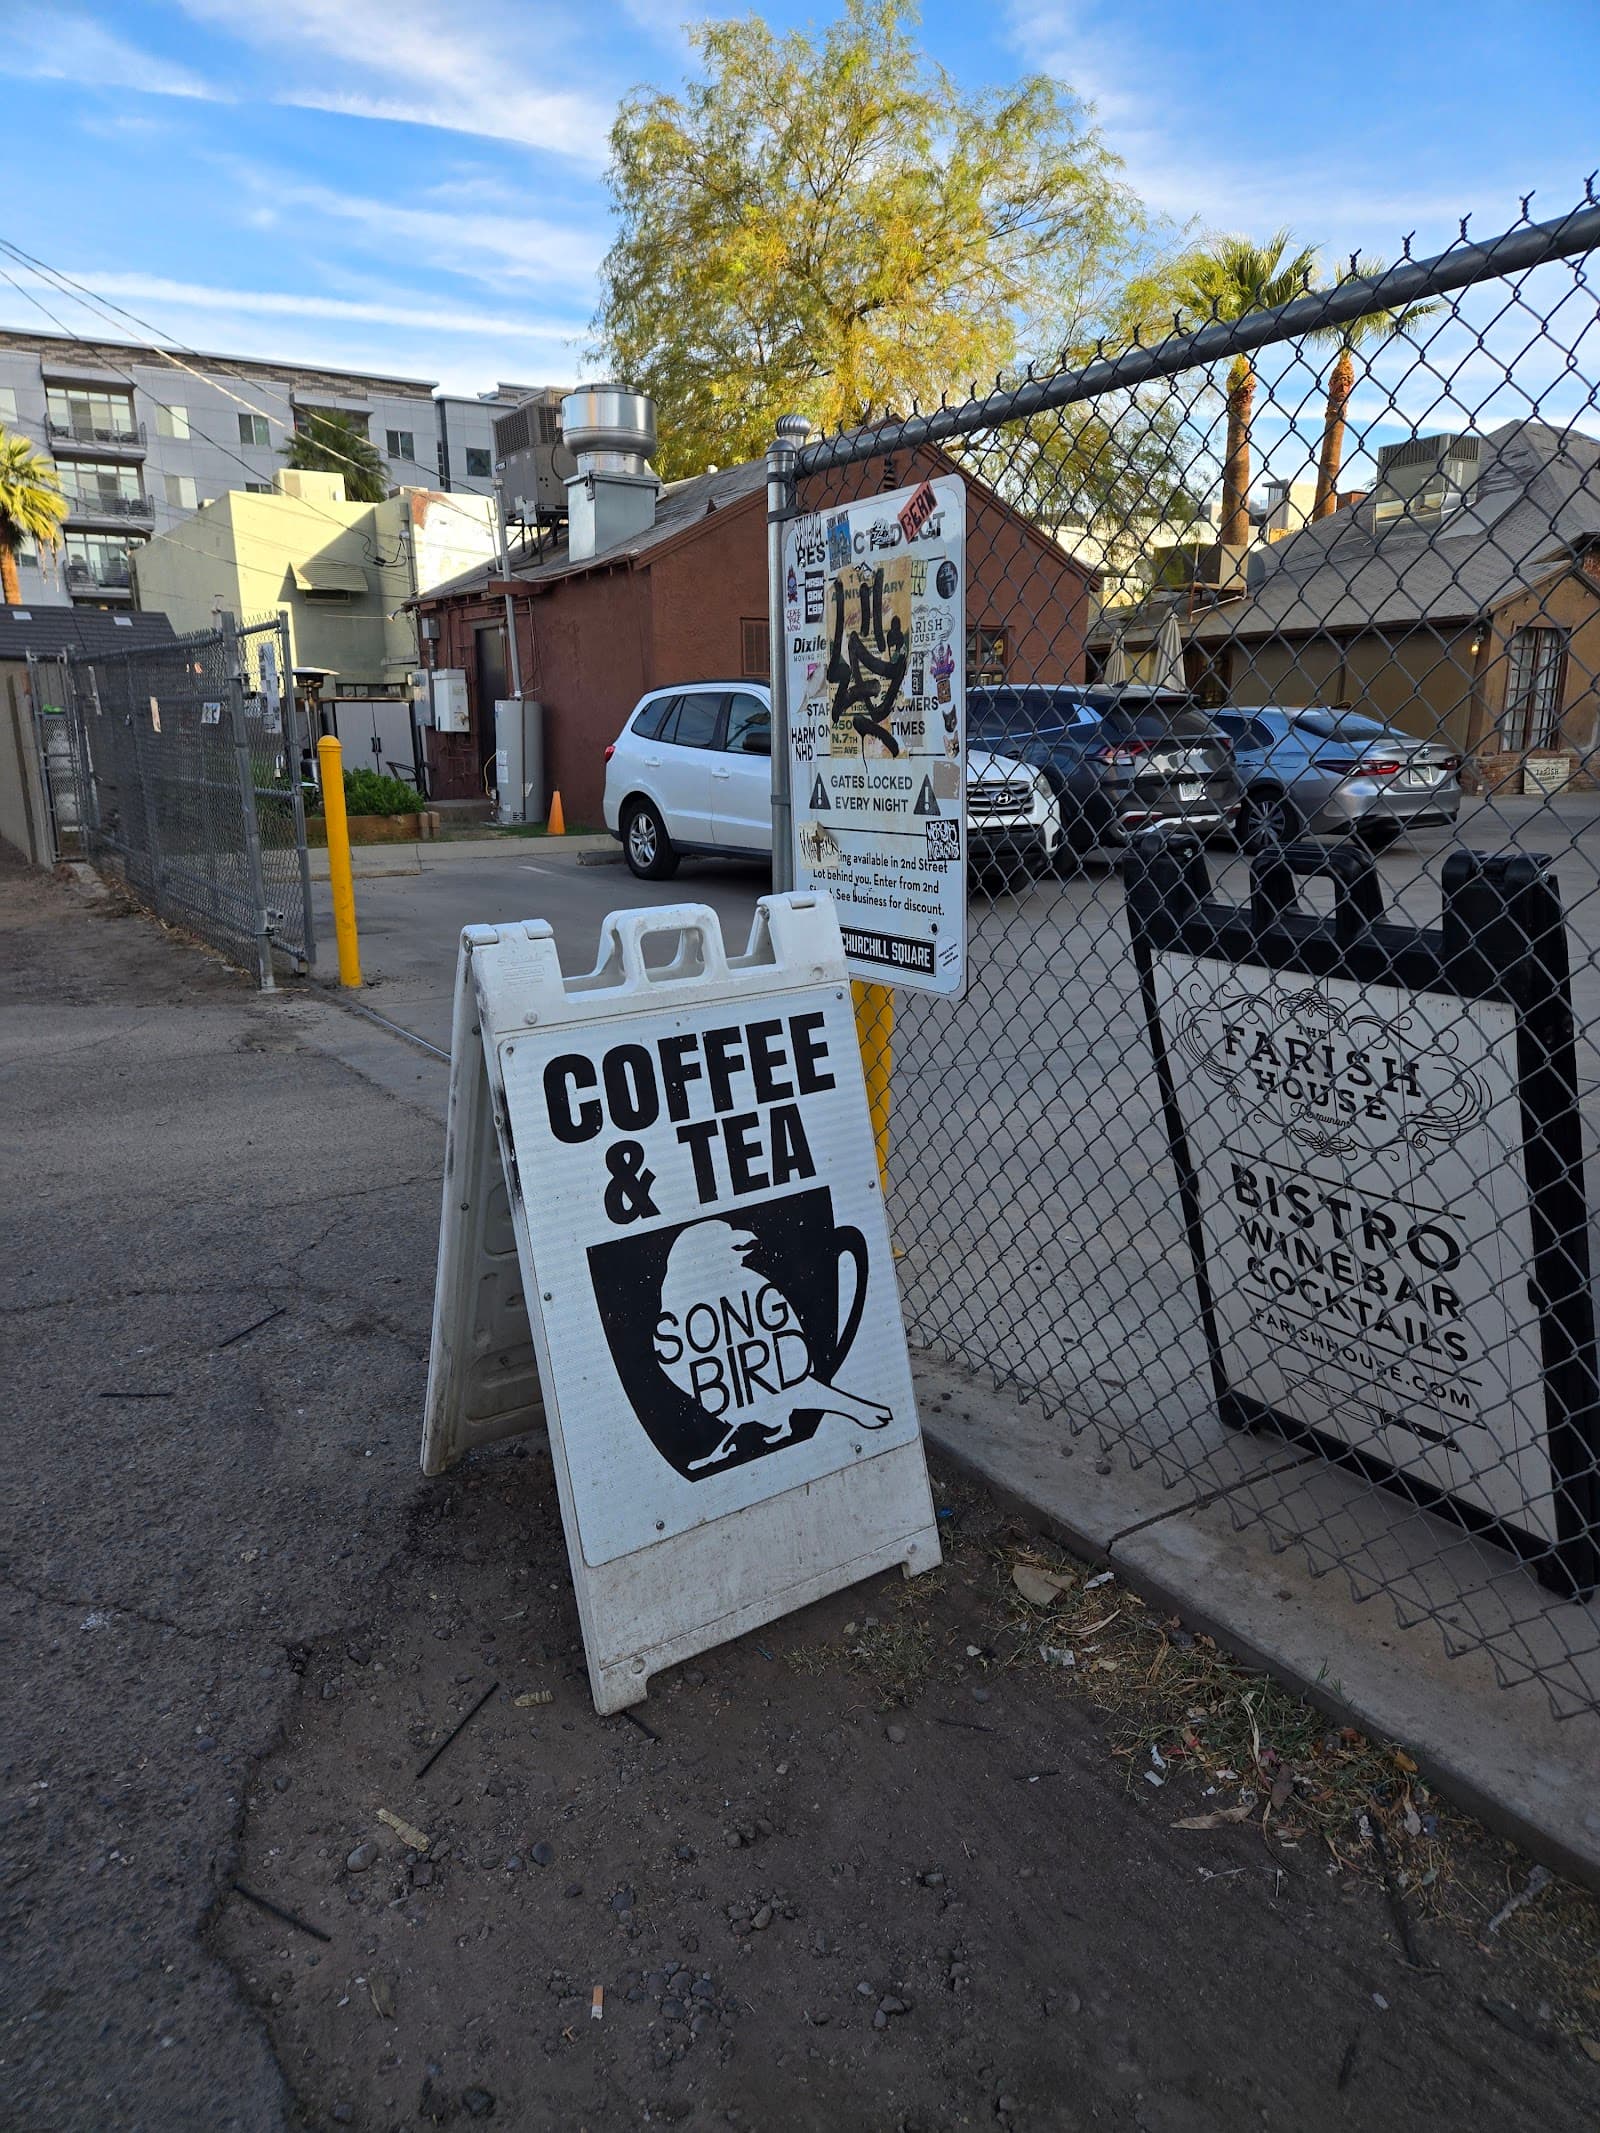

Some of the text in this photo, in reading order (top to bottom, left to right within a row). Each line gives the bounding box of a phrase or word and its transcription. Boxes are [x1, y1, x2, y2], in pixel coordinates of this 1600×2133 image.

[912, 618, 942, 633] RISH
[912, 632, 935, 643] OUSE
[792, 726, 816, 744] HARM
[891, 721, 925, 736] TIMES
[796, 744, 813, 761] NHD
[844, 747, 858, 755] AVE
[831, 775, 912, 790] GATES LOCKED
[836, 796, 908, 813] EVERY NIGHT
[853, 852, 889, 867] available
[891, 855, 898, 867] in
[901, 856, 916, 870] 2nd
[918, 858, 948, 874] Street
[813, 869, 939, 894] Lot behind you. Enter from 2nd
[836, 889, 850, 901] See
[853, 888, 887, 907] business
[889, 895, 901, 909] for
[904, 898, 945, 916] discount.
[892, 942, 930, 968] SQUARE
[1296, 1025, 1326, 1039] THE
[1223, 1024, 1421, 1097] FARISH
[543, 1011, 835, 1143] COFFEE
[1255, 1069, 1387, 1120] HOUSE
[604, 1103, 816, 1225] & TEA
[1231, 1162, 1461, 1272] BISTRO
[1240, 1214, 1464, 1321] WINEBAR
[1247, 1257, 1468, 1362] COCKTAILS
[653, 1282, 789, 1364] SONG
[689, 1329, 811, 1416] BIRD
